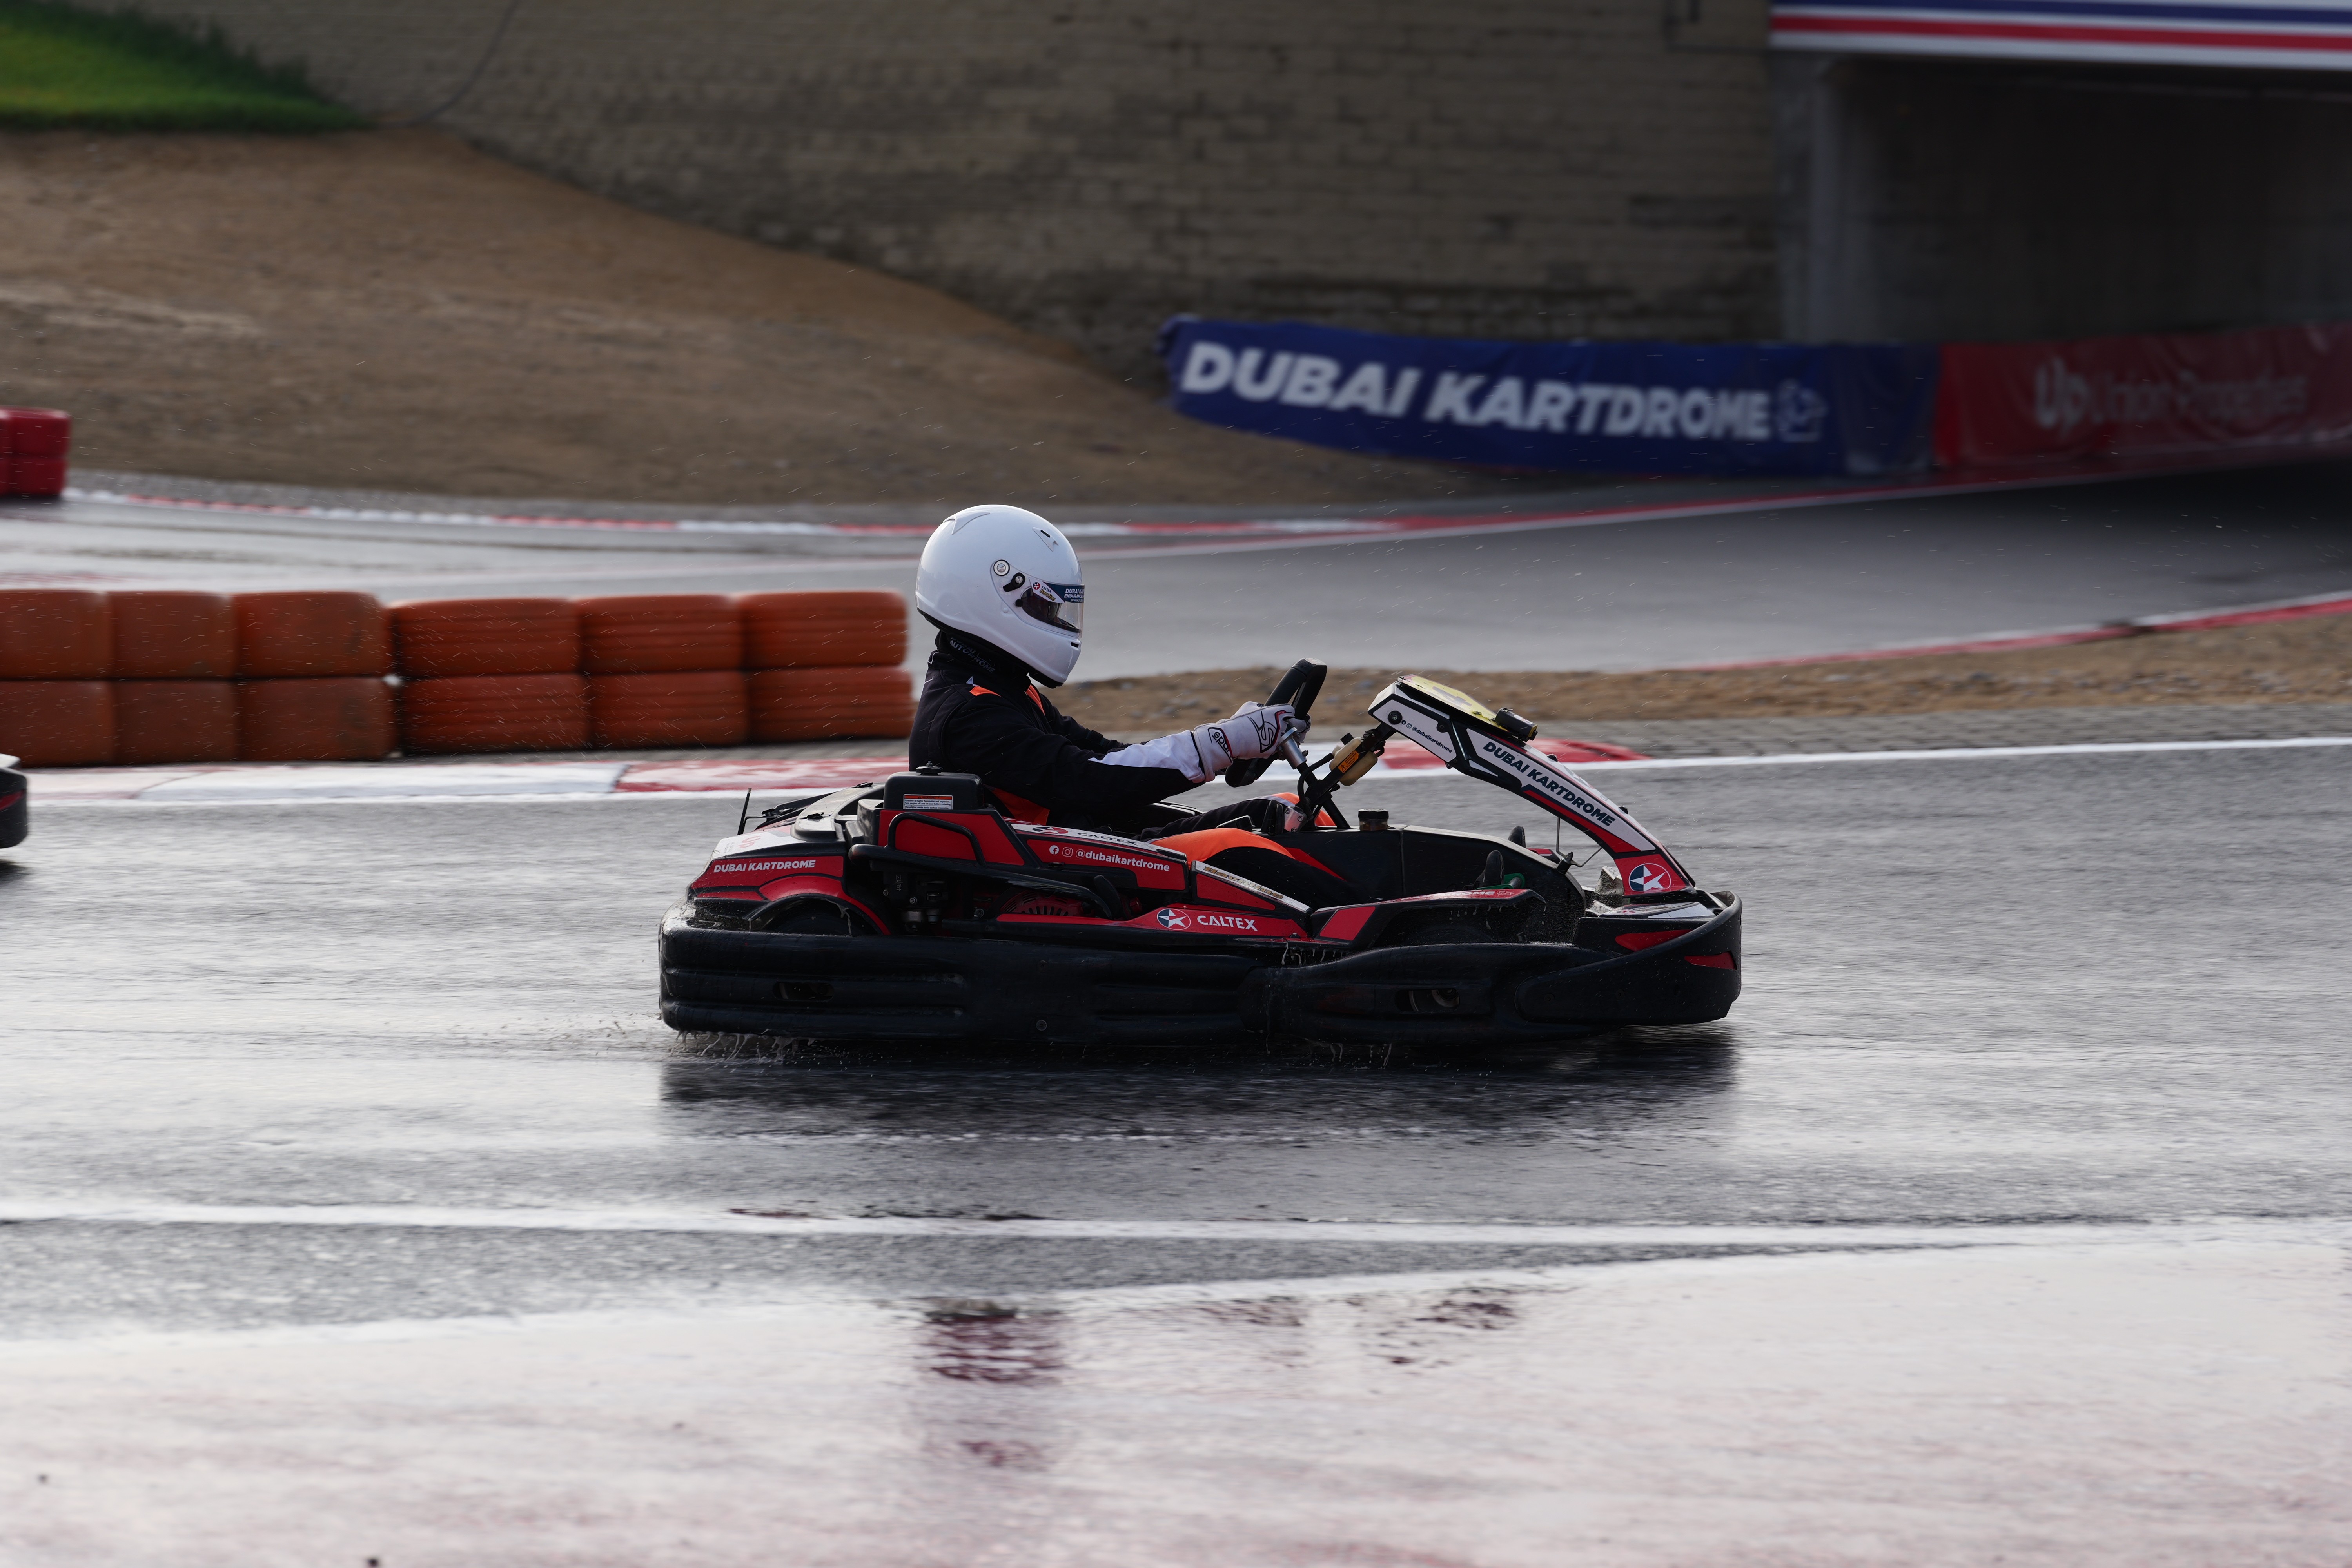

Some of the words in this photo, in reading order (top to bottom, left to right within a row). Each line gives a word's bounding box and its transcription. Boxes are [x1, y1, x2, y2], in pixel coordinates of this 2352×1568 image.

[1181, 341, 1422, 417] DUBAI
[1424, 373, 1771, 440] KARTDROME
[1412, 726, 1452, 753] @dubaikartdrome
[1483, 741, 1530, 773] DUBAI
[1527, 768, 1616, 827] KARTDROME
[1077, 832, 1138, 846] CALTEX
[713, 862, 748, 873] DUBAI
[748, 860, 816, 871] KARTDROME
[1075, 849, 1170, 872] @dubaikartdrome
[1197, 915, 1258, 932] CALTEX
